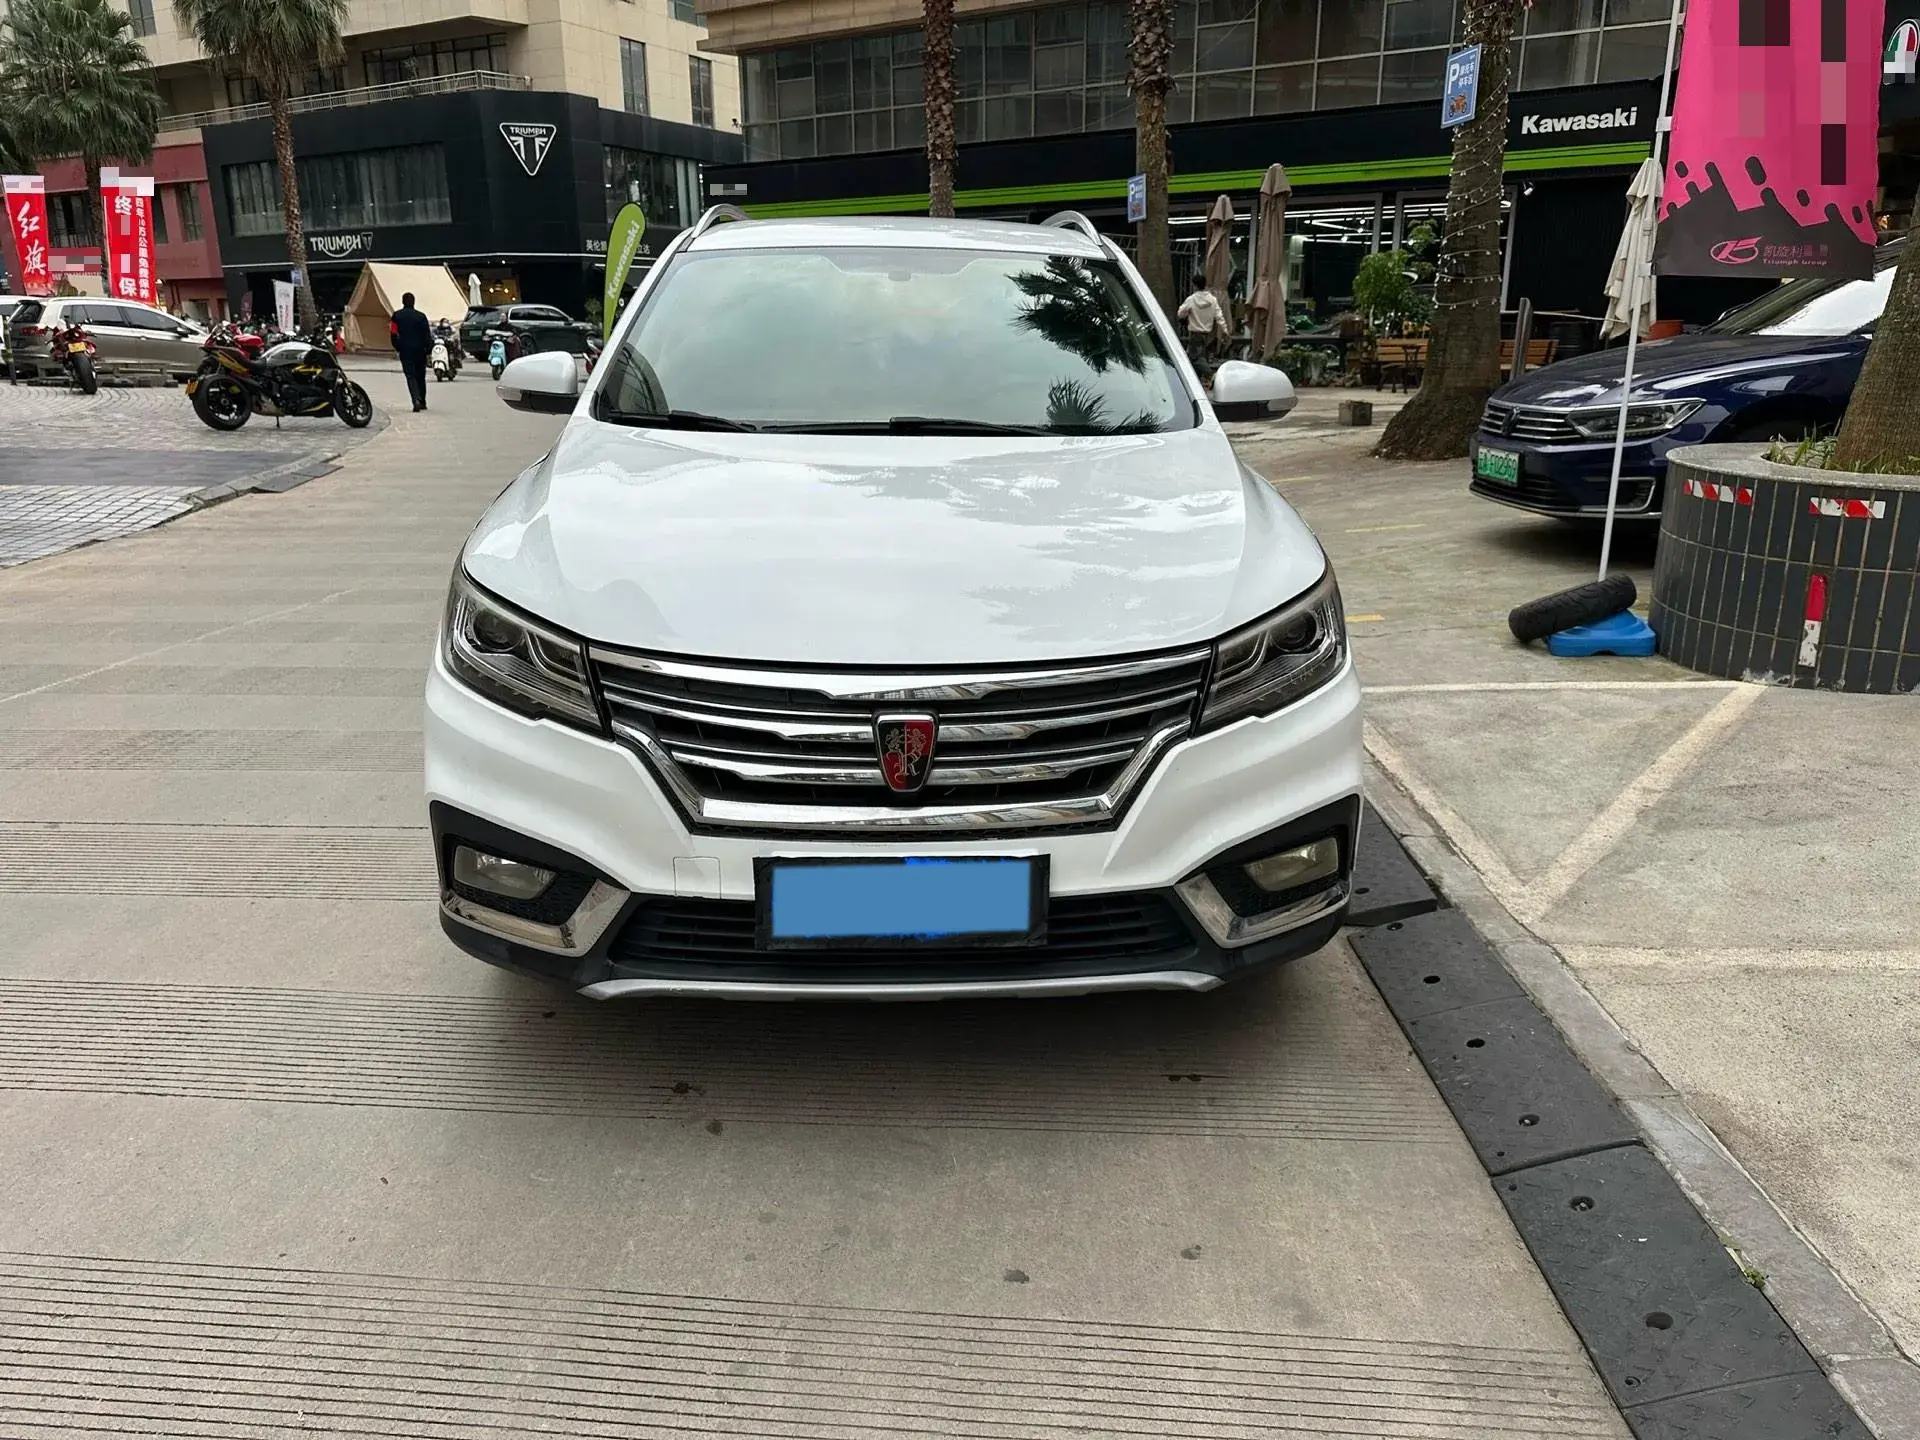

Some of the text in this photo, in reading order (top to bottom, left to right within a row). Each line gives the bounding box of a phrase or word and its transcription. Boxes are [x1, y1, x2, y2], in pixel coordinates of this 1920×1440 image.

[1447, 63, 1460, 95] P
[510, 126, 546, 137] TRIUMPH
[1521, 106, 1638, 135] Kawasaki
[17, 200, 47, 275] 红旗
[310, 235, 362, 258] TRIUMPH
[607, 219, 641, 299] Kawasaki
